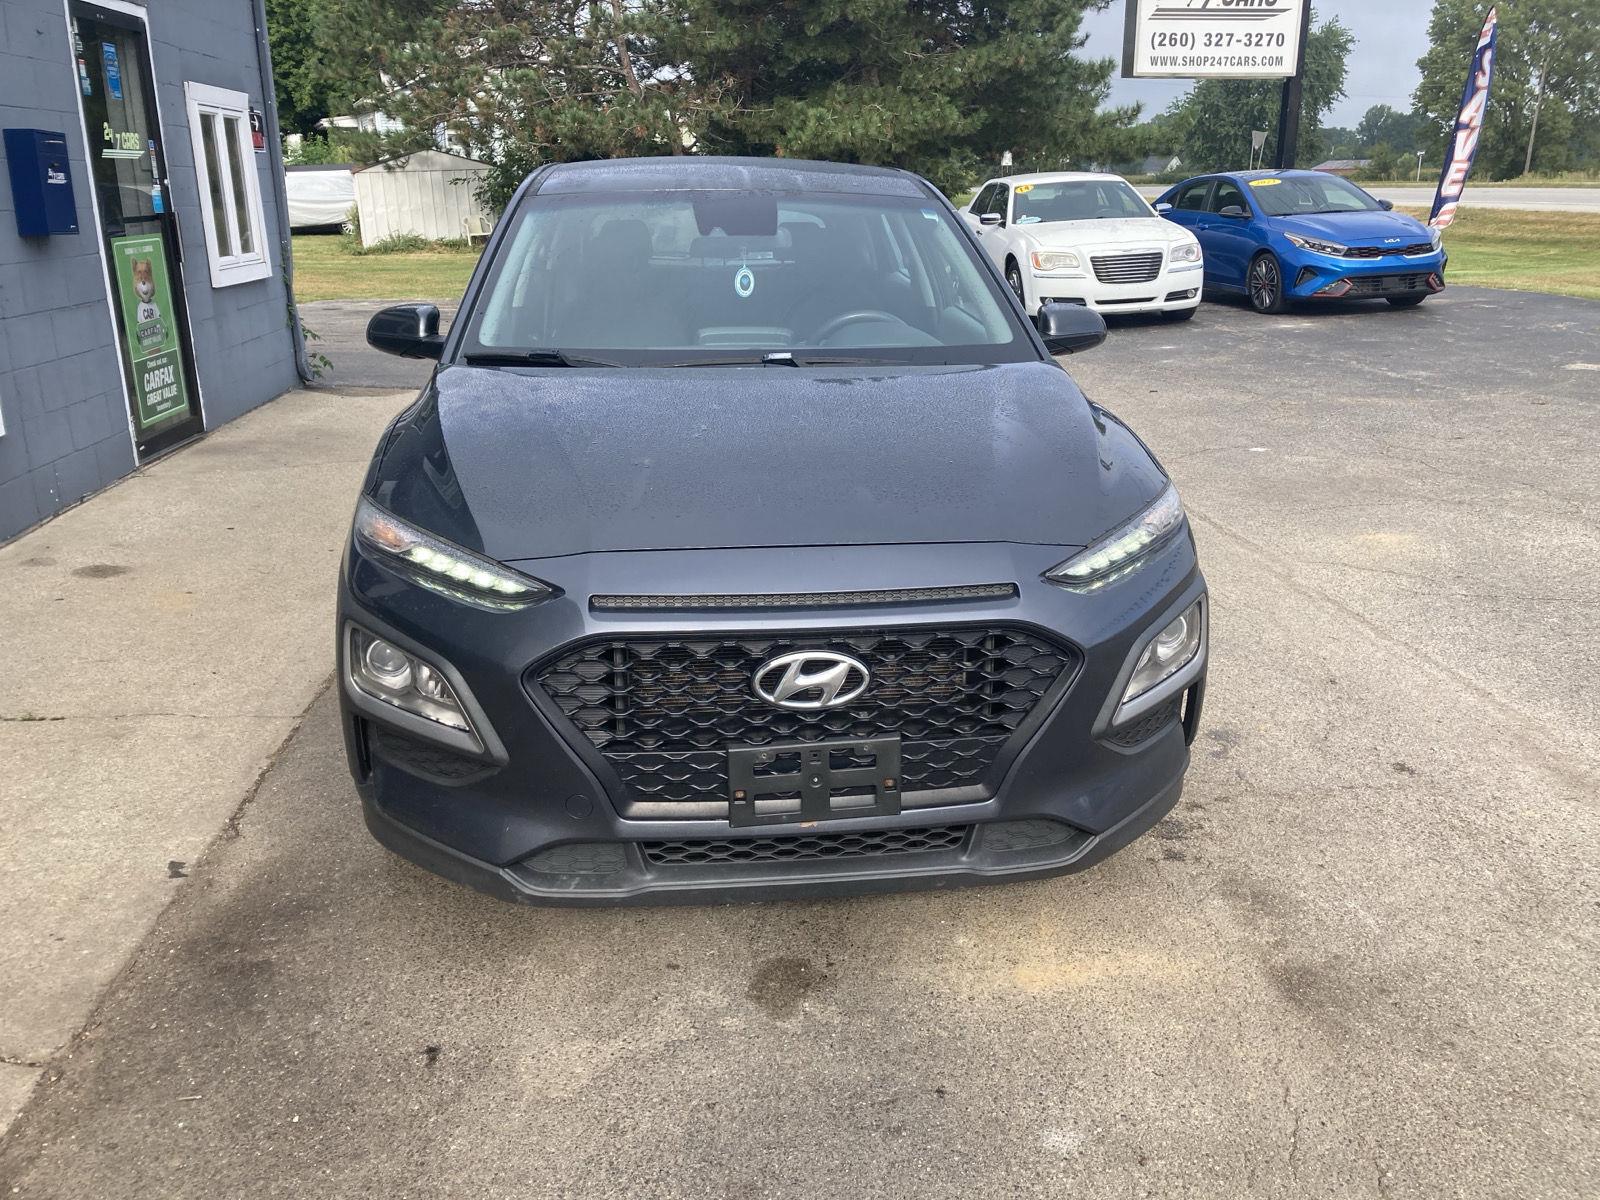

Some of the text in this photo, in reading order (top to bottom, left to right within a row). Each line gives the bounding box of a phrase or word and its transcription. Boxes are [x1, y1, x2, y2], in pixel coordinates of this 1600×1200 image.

[1151, 32, 1285, 50] (260) 327-3270
[1150, 56, 1284, 67] WWW.SHOP247CARS.COM
[143, 307, 155, 320] CAR
[144, 365, 174, 392] CARFAX
[147, 390, 162, 406] GREAT
[162, 384, 177, 399] VALUE
